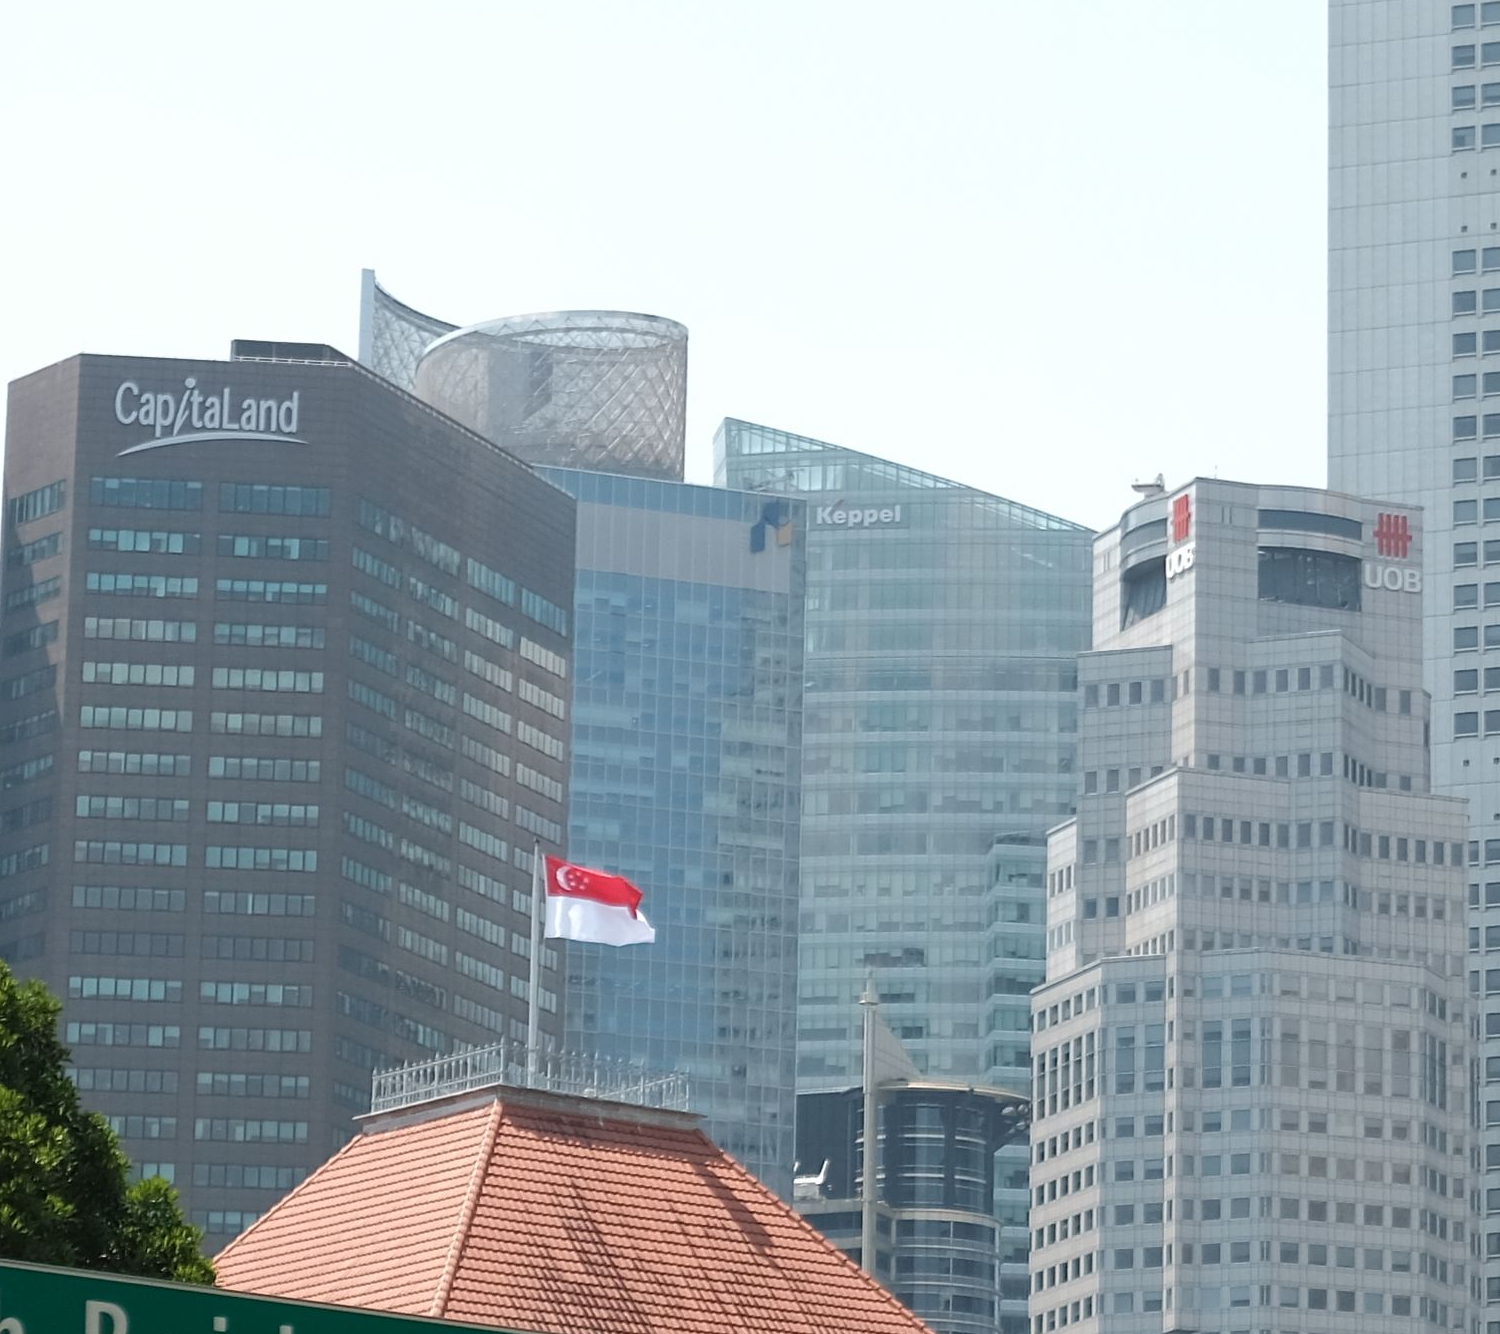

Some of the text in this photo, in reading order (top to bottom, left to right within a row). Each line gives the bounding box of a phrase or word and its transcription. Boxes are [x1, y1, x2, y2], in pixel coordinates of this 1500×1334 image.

[115, 378, 300, 438] CapitaLand
[816, 504, 901, 527] Keppel
[1165, 542, 1196, 579] UOB
[1365, 564, 1422, 593] UOB
